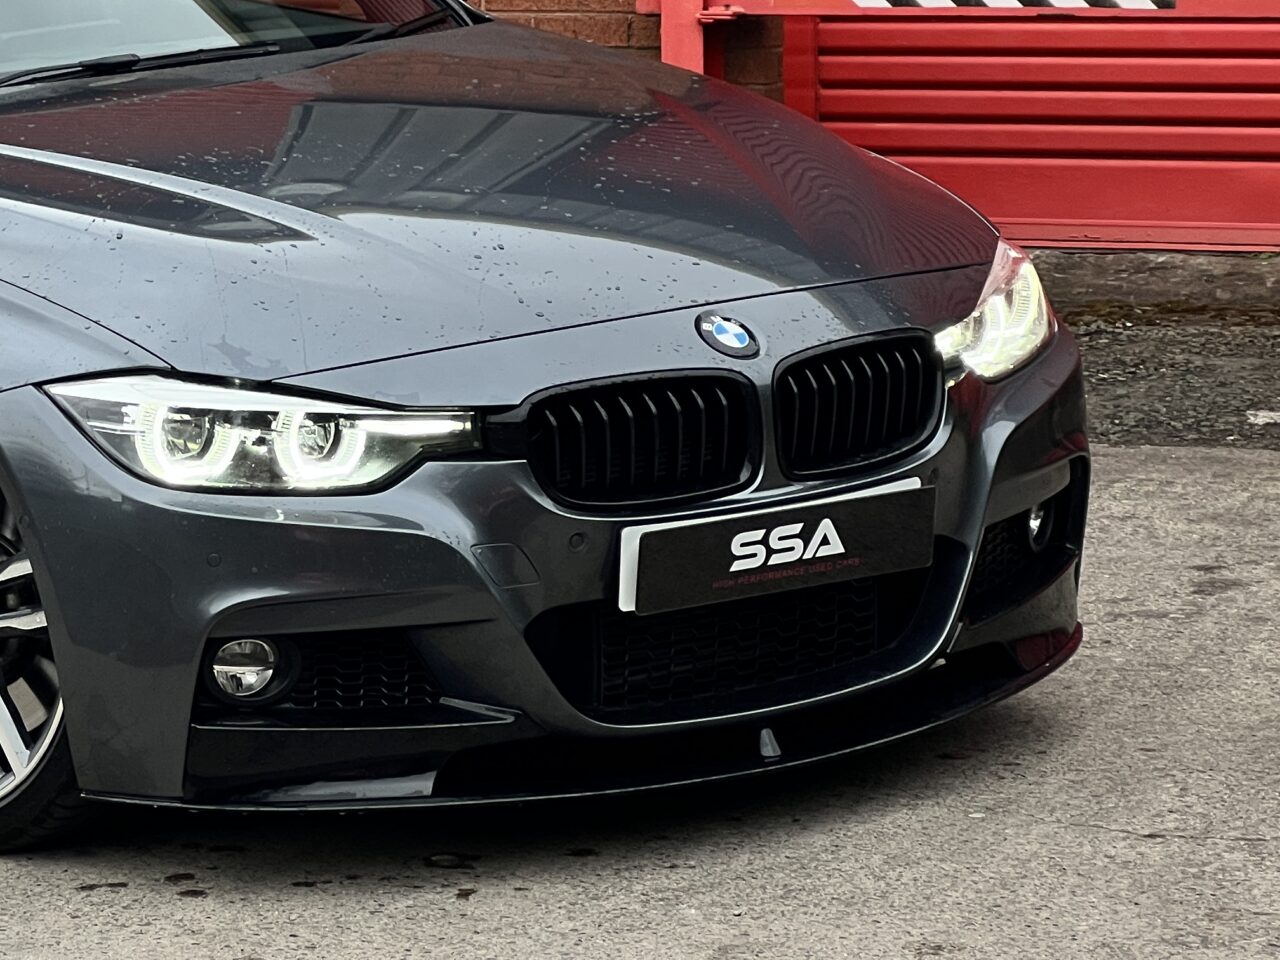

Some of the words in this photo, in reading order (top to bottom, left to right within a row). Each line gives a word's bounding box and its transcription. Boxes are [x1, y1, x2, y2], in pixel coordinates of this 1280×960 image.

[728, 517, 846, 572] SSA
[737, 566, 805, 585] PERFORMANCE
[808, 562, 833, 574] USED
